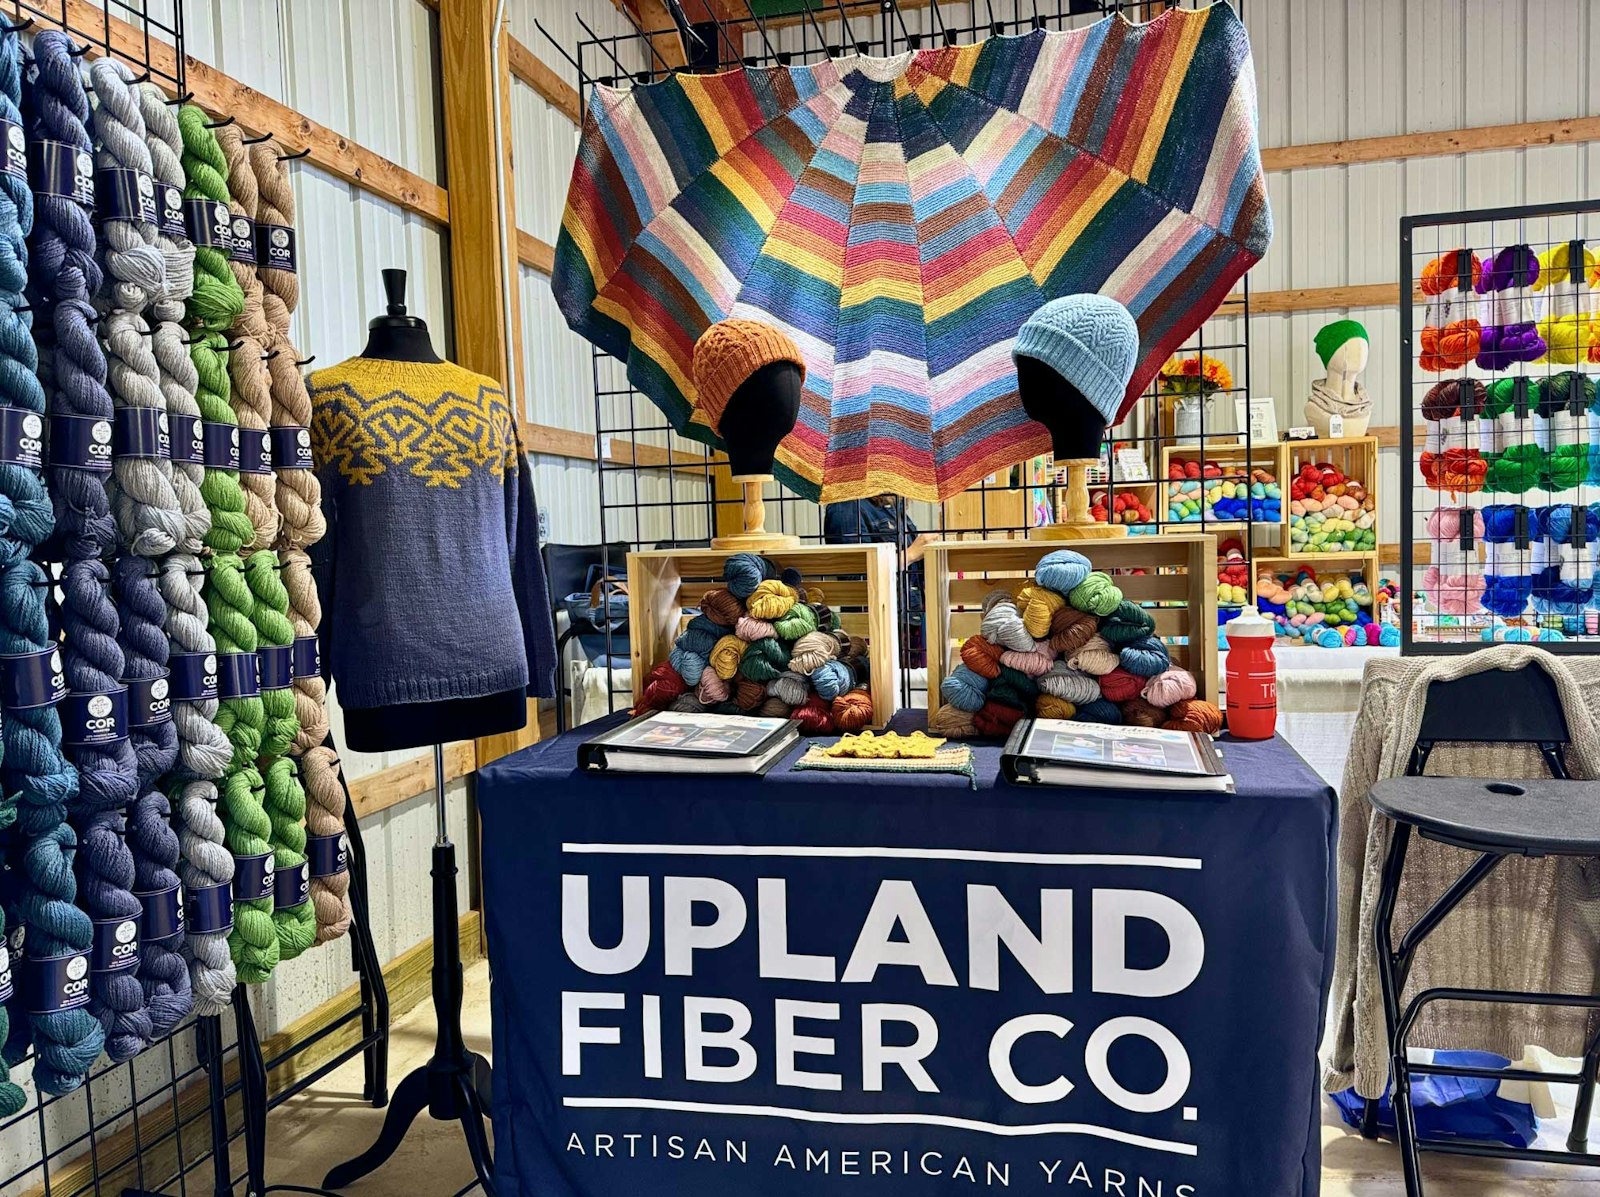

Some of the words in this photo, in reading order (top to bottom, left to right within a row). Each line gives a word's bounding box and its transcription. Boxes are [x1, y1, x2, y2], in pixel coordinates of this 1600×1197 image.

[164, 209, 184, 222] COR
[232, 238, 252, 249] COR
[270, 247, 290, 258] COR
[19, 438, 42, 452] COR
[89, 444, 112, 455] COR
[150, 698, 170, 712] COR
[86, 718, 115, 730] COR
[562, 874, 1204, 997] UPLAND
[113, 942, 137, 956] COR
[63, 979, 88, 994] COR
[562, 991, 940, 1092] FIBER
[989, 1014, 1197, 1120] CO.
[567, 1132, 747, 1164] ARTISAN
[774, 1144, 1009, 1187] AMERICAN
